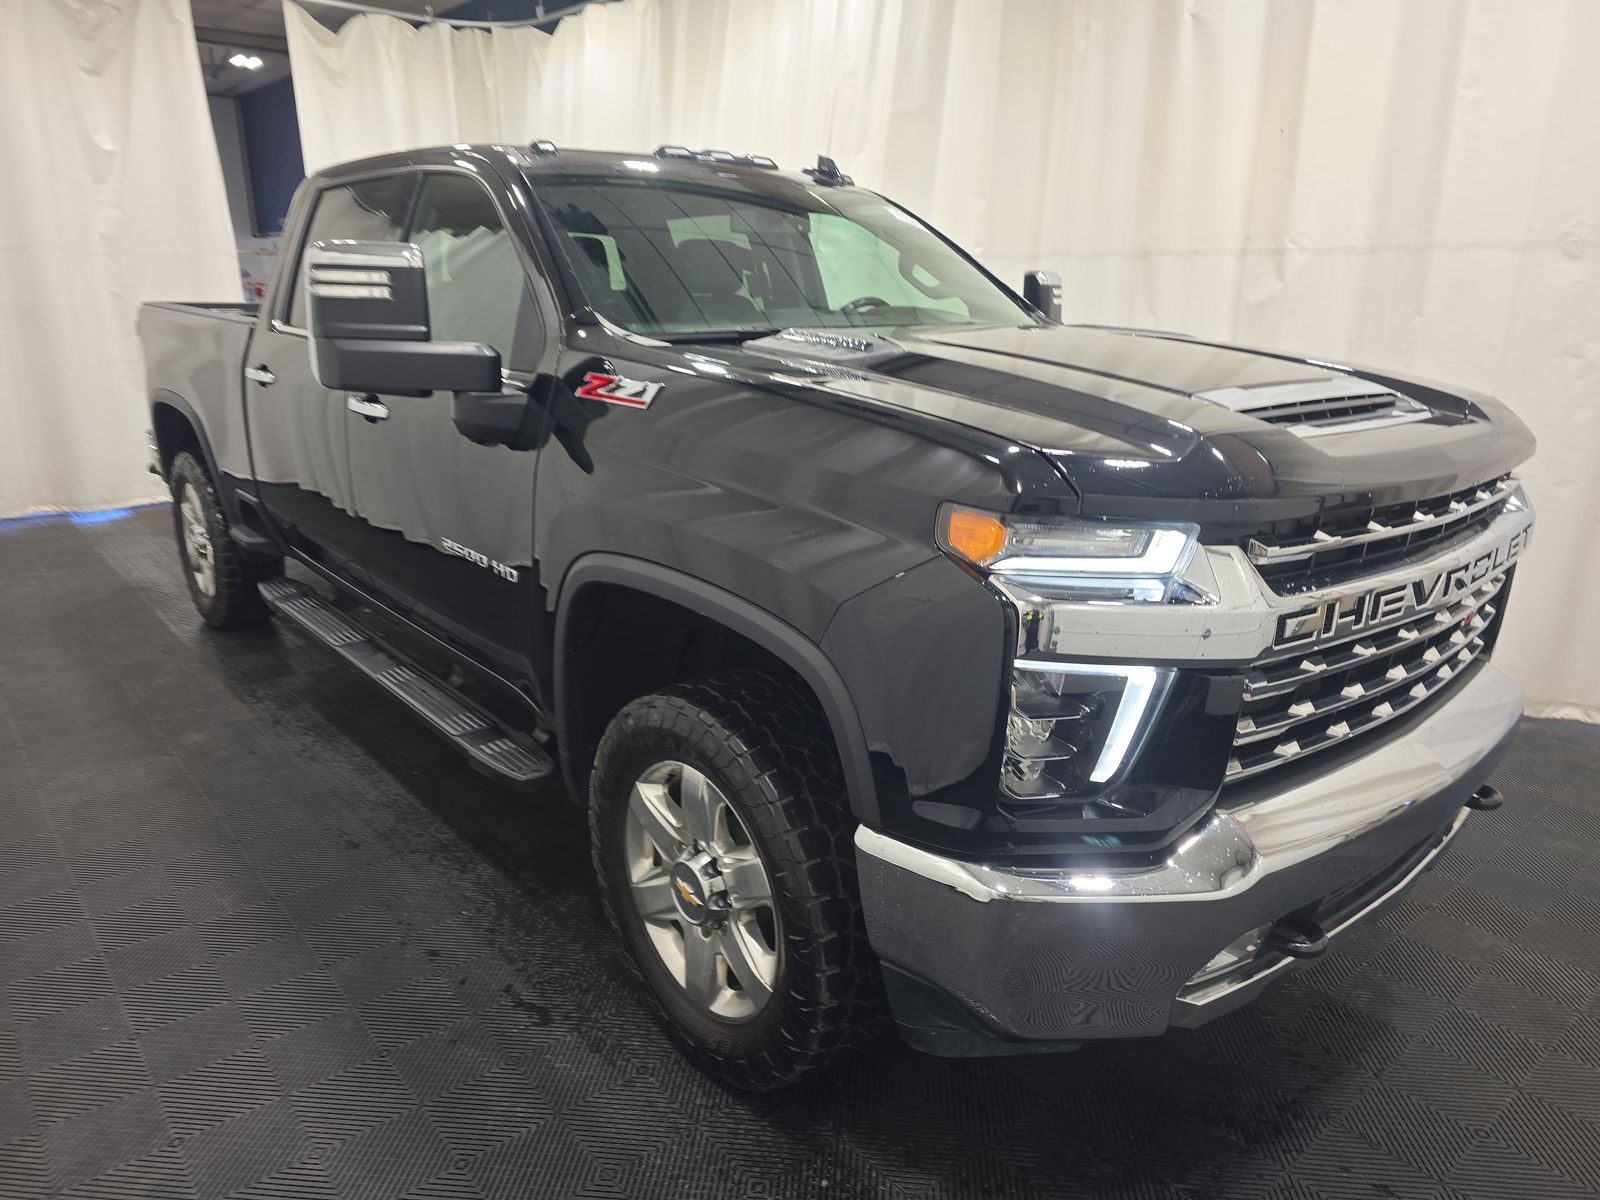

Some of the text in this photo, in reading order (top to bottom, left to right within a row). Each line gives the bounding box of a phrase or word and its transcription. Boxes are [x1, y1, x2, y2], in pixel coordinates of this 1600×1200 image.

[574, 372, 665, 410] Z71
[440, 536, 519, 583] 2500 HD
[1272, 523, 1532, 650] CHEVROLET
